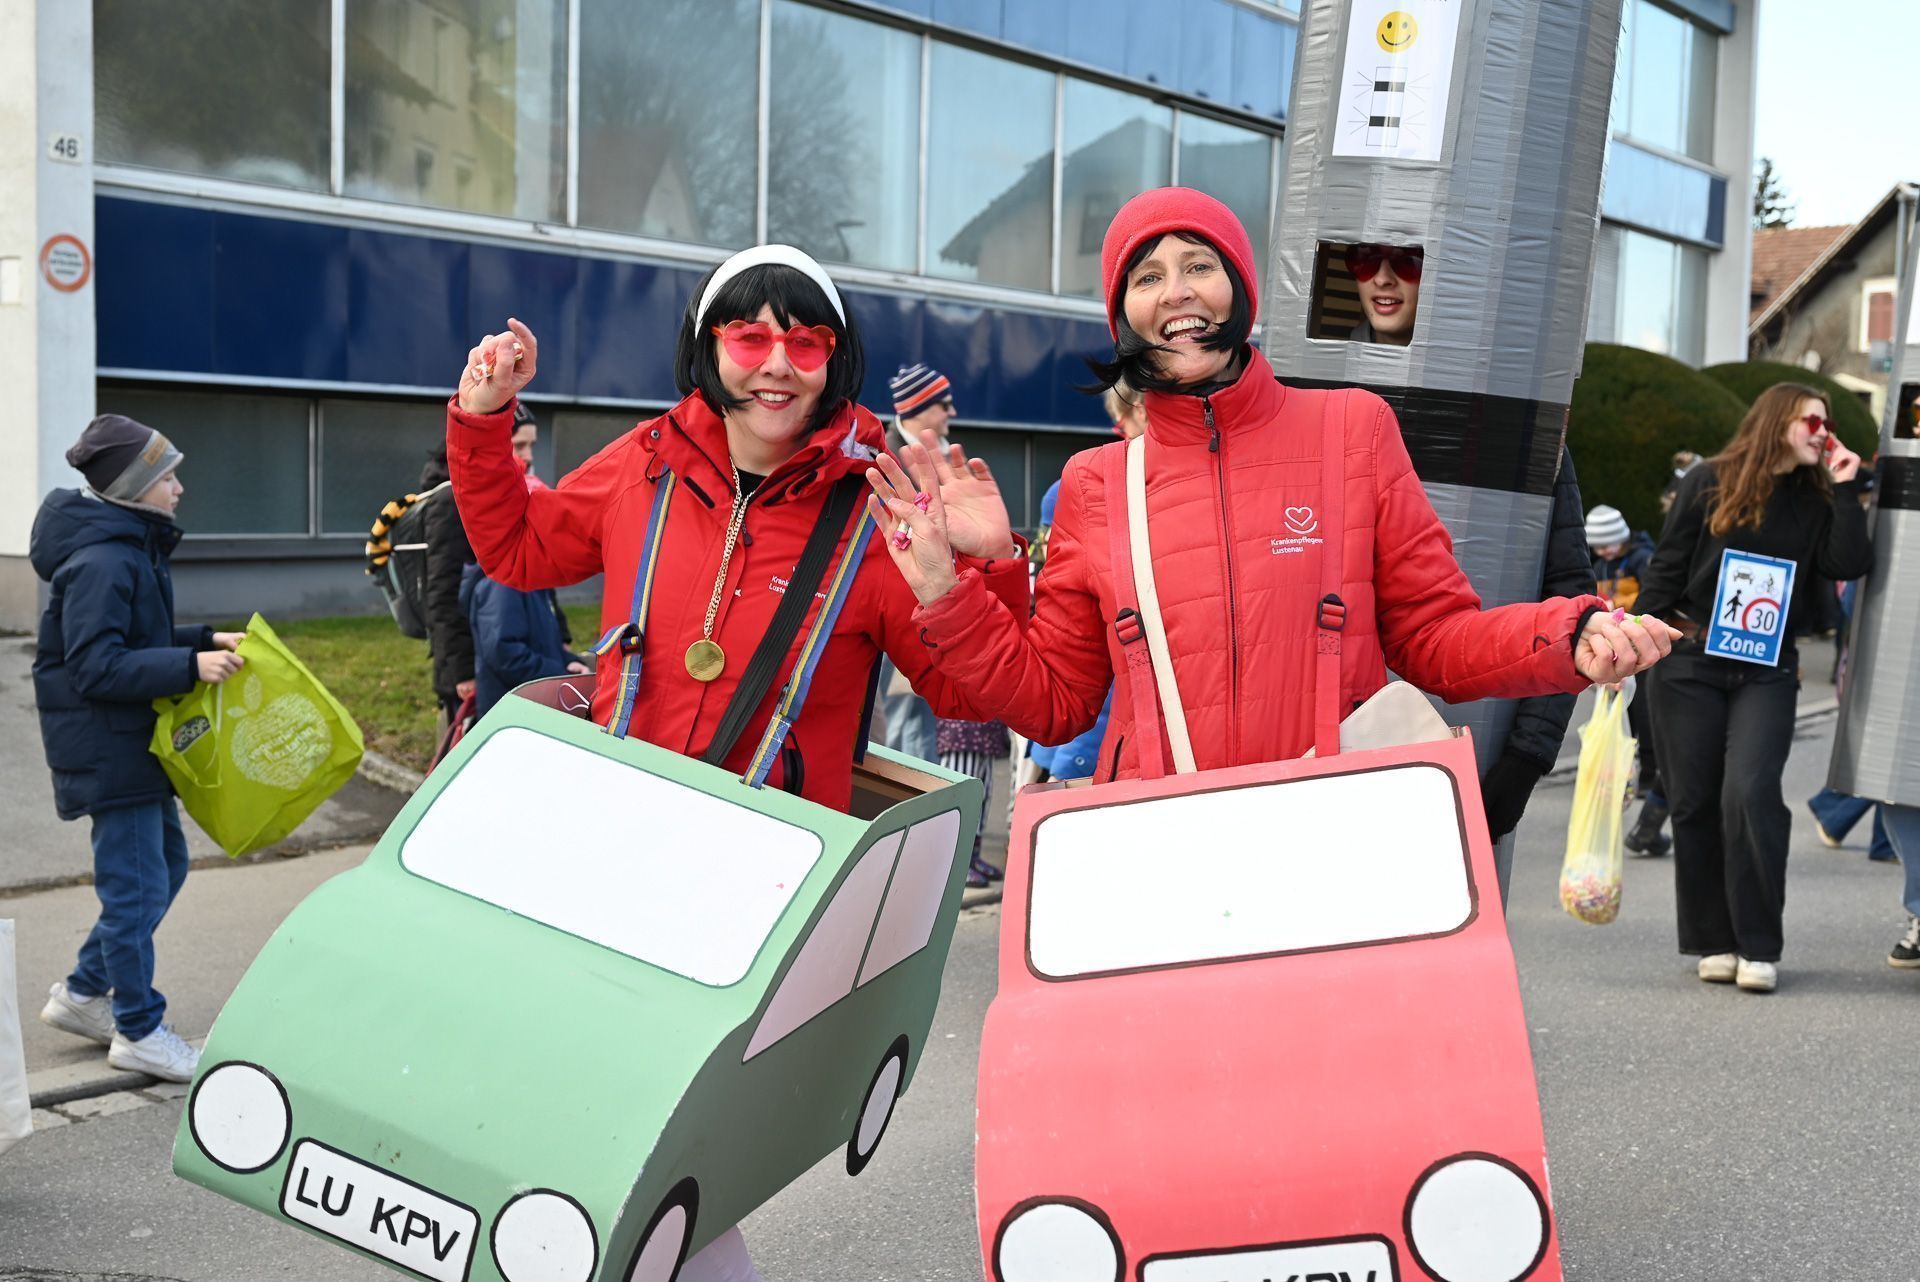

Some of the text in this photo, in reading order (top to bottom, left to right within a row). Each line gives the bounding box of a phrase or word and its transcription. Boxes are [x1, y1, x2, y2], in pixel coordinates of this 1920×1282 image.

[54, 138, 78, 158] 46
[1271, 546, 1304, 555] Lustenau
[1752, 608, 1775, 632] 30
[1718, 631, 1767, 658] Zone
[295, 1166, 461, 1262] LU KPV
